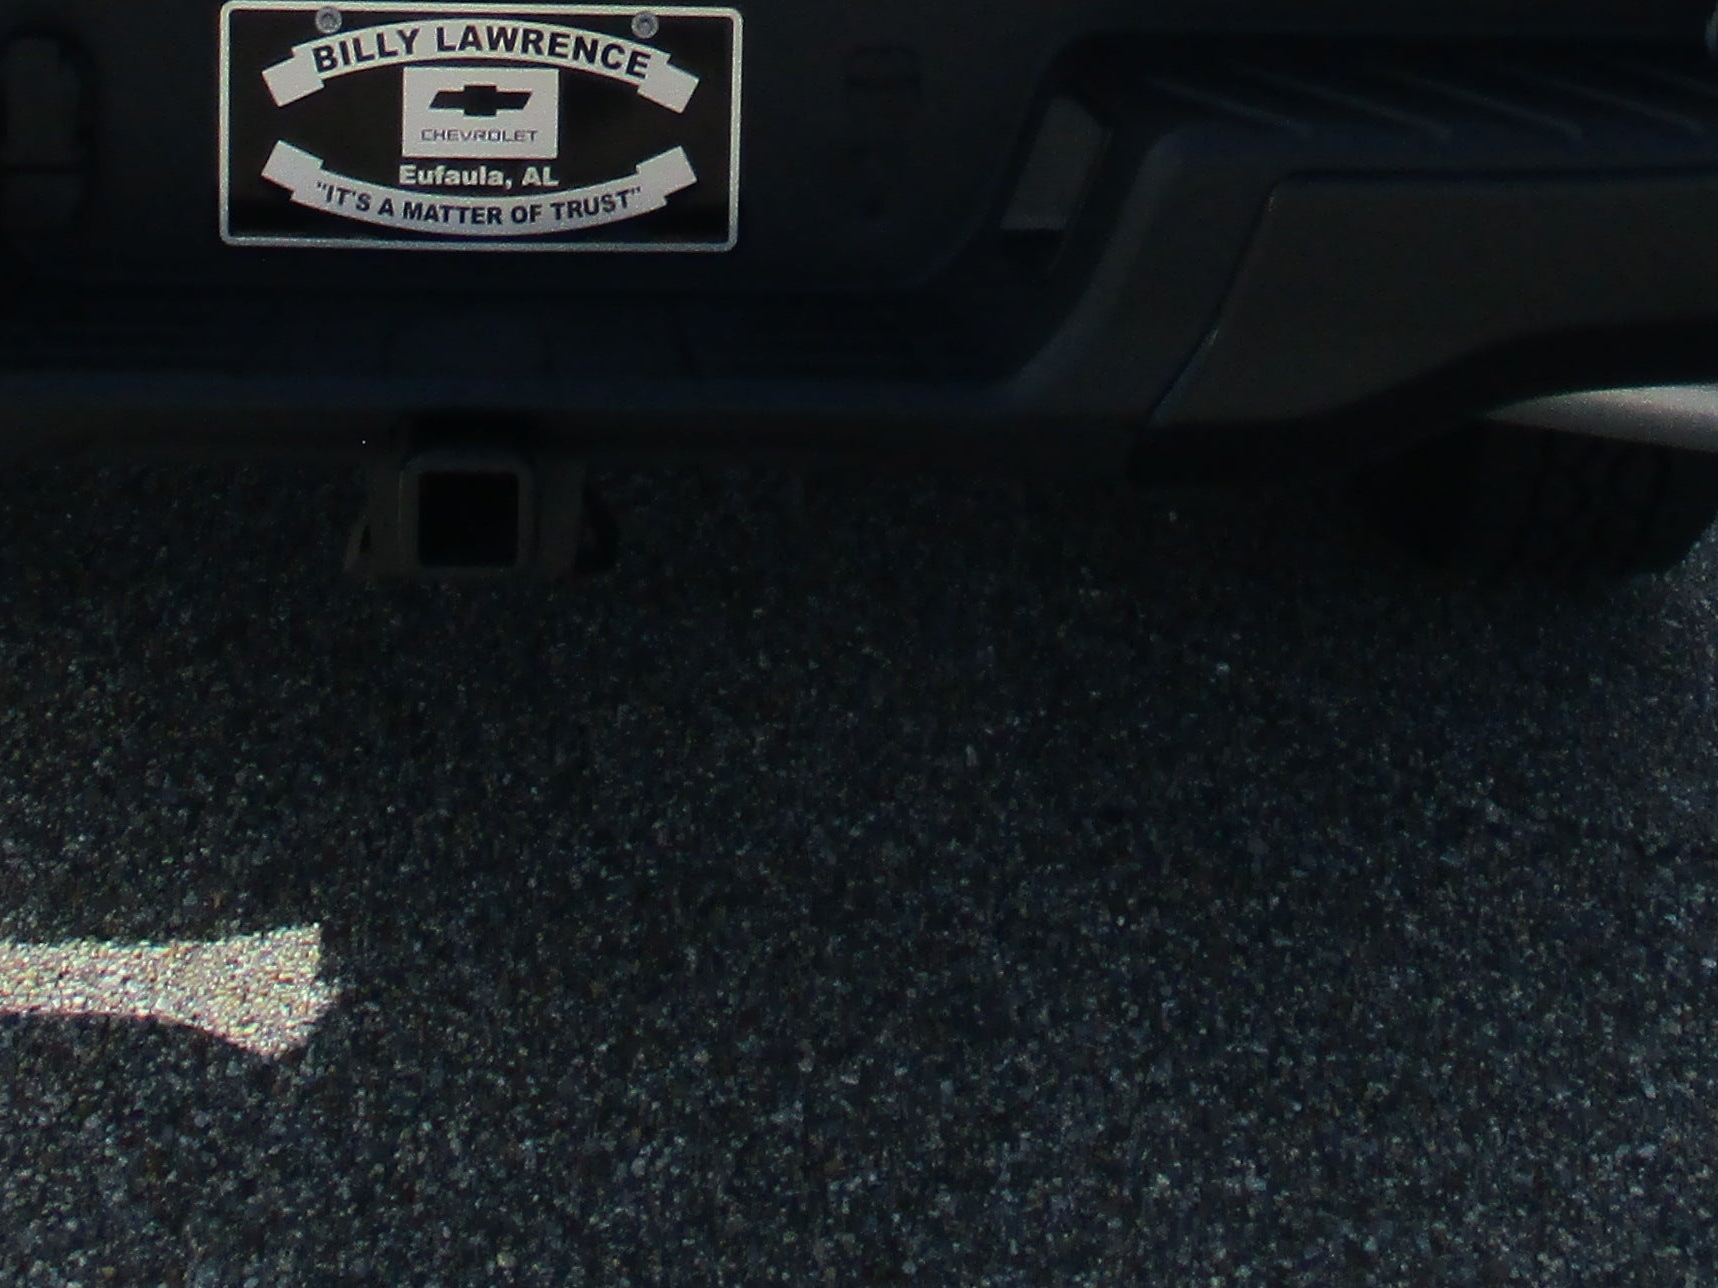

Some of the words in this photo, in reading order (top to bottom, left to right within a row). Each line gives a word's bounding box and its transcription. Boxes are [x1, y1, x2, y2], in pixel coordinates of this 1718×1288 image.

[312, 27, 421, 75] BILLY
[435, 24, 652, 79] LAWRENCE
[420, 127, 539, 143] CHEVROLET
[399, 164, 512, 190] Eufaula,
[521, 164, 560, 187] AL
[315, 181, 372, 214] "IT'S
[377, 197, 396, 216] A
[401, 199, 503, 226] MATTER
[509, 202, 543, 225] OF
[549, 185, 642, 223] TRUST"
